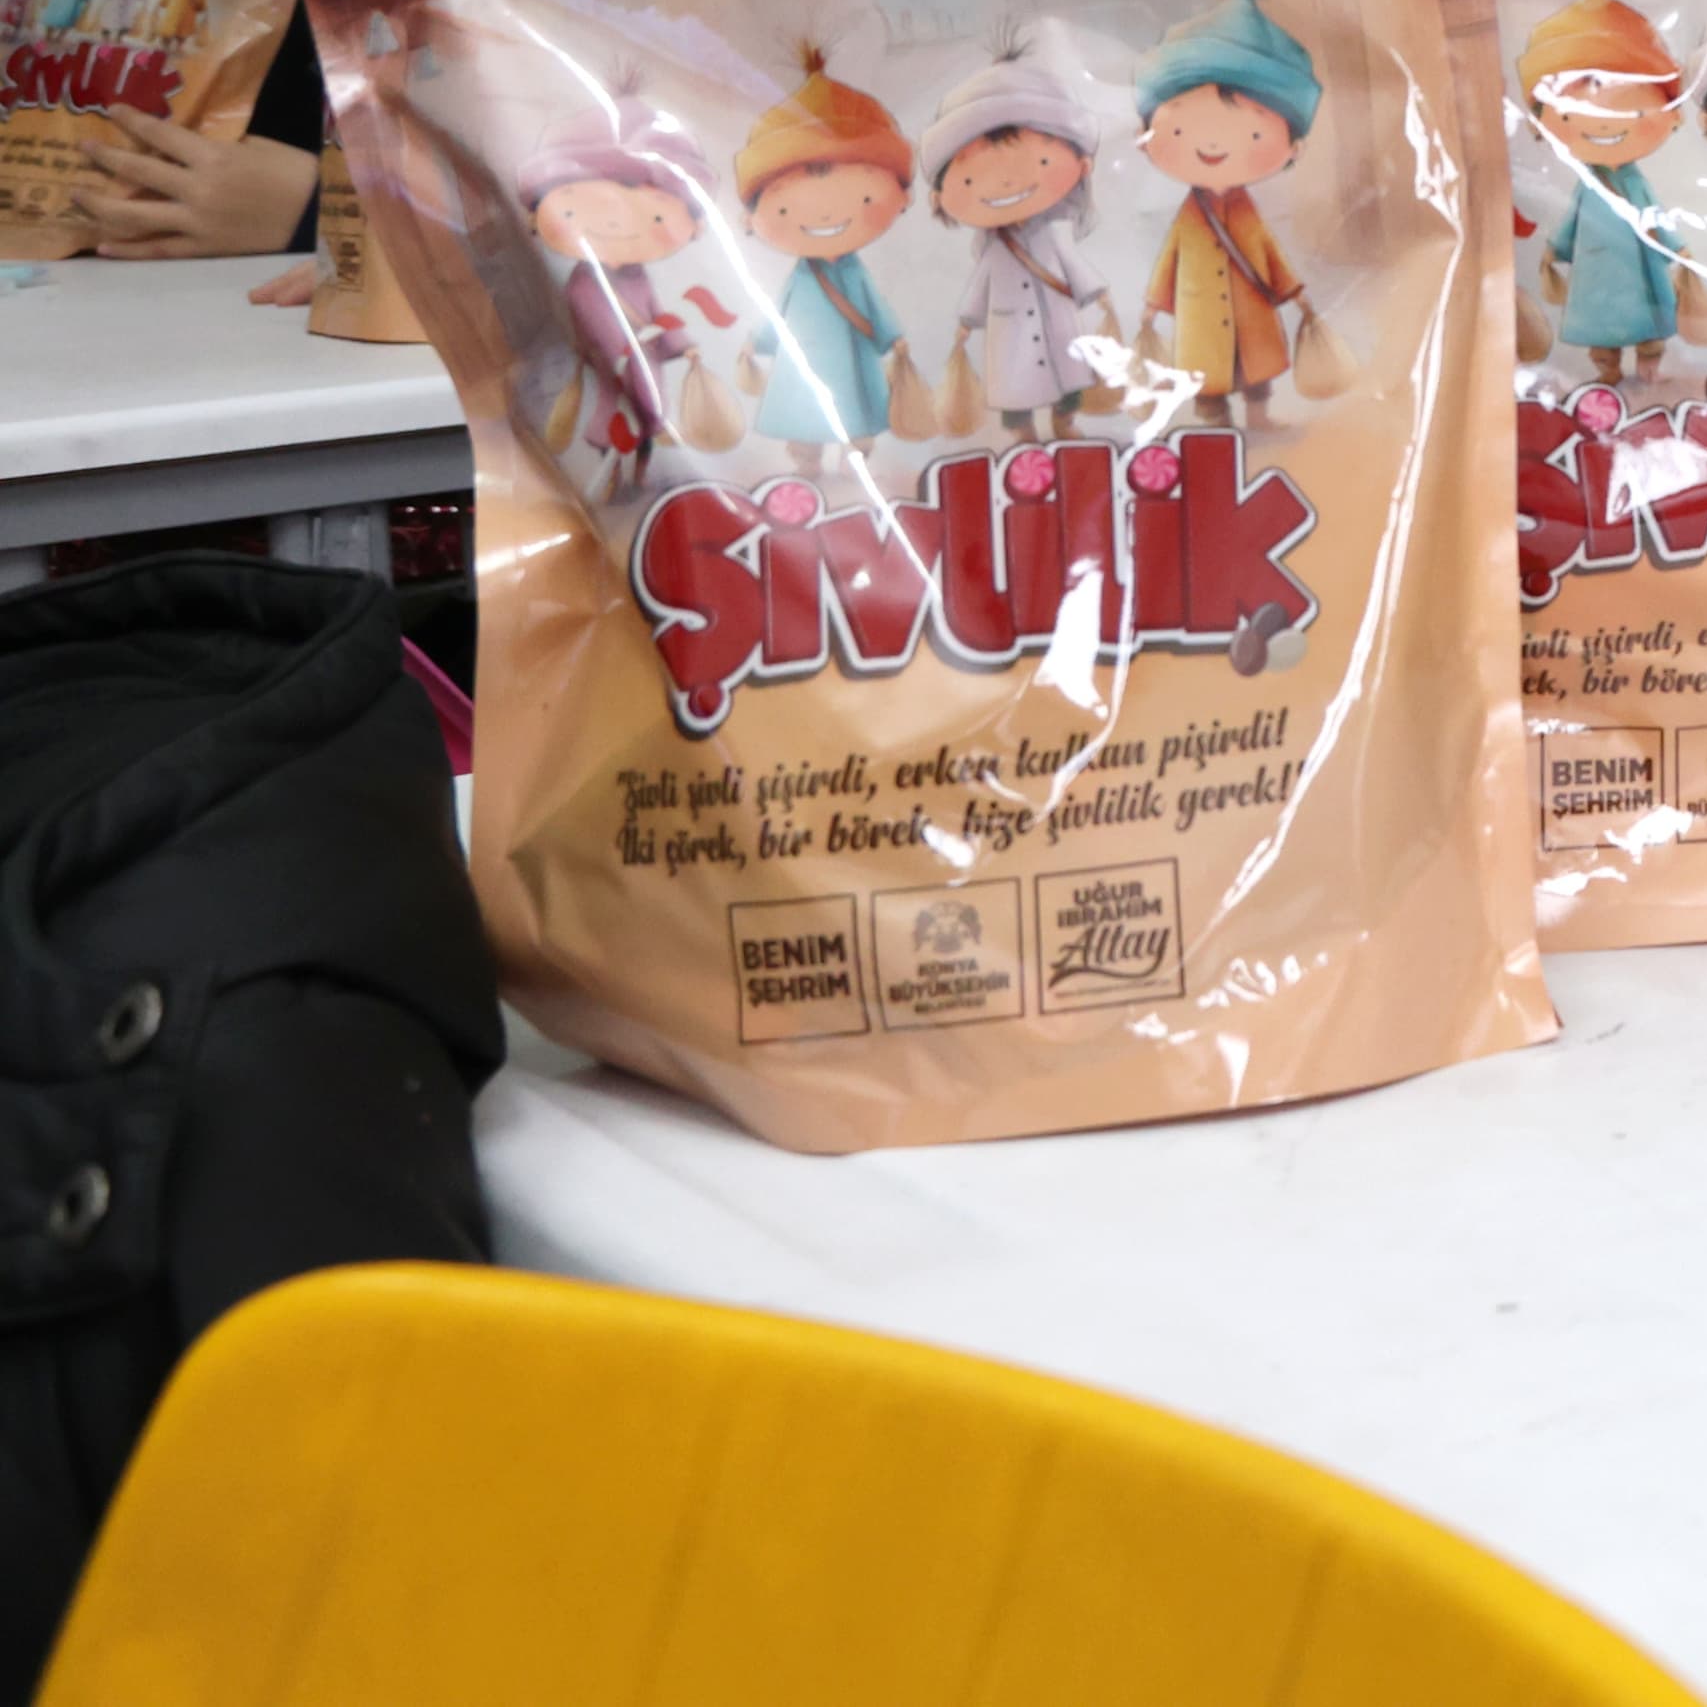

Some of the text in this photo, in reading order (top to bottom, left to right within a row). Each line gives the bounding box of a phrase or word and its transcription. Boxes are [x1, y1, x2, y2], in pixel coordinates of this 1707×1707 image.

[1521, 627, 1570, 660] ivli
[1522, 669, 1568, 700] ek,
[1582, 667, 1630, 695] bir
[895, 744, 1000, 790] erken
[1157, 706, 1290, 778] pişirdi!
[1551, 756, 1655, 788] BENİM
[758, 819, 814, 861] bir
[826, 811, 934, 855] börek
[1044, 782, 1164, 847] şivlilik
[741, 933, 847, 972] BENİM
[747, 969, 852, 1009] ŞEHRİM
